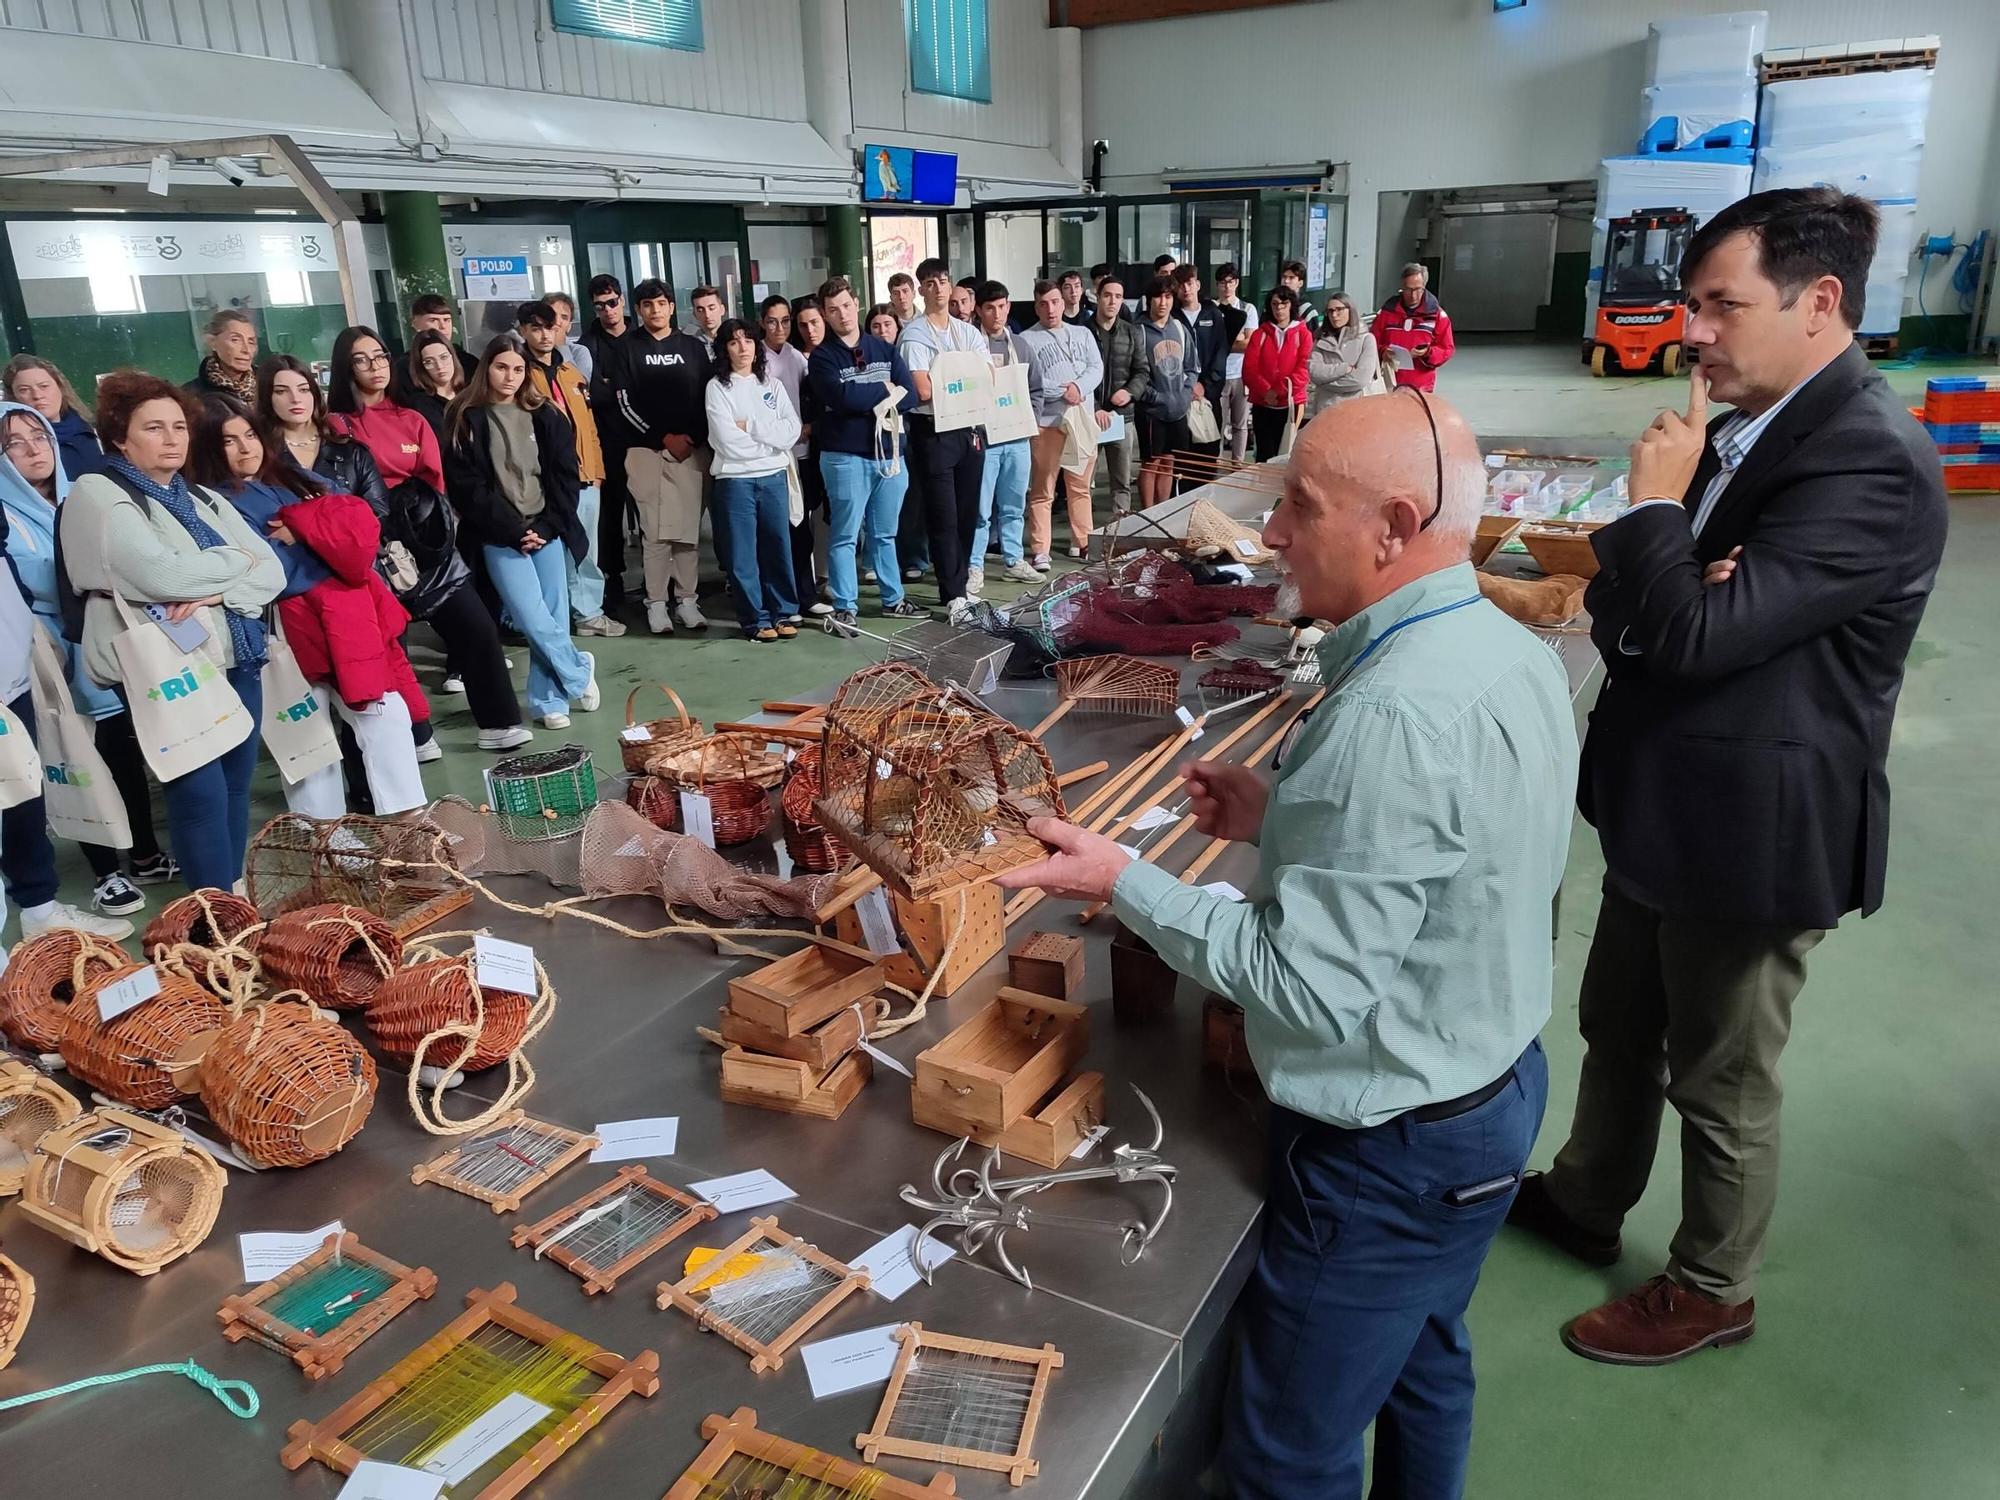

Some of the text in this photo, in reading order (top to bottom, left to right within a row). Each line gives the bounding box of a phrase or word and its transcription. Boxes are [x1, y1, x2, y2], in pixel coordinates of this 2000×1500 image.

[480, 260, 513, 272] POLBO
[1614, 315, 1665, 324] DOOSAN
[645, 353, 685, 366] NASA
